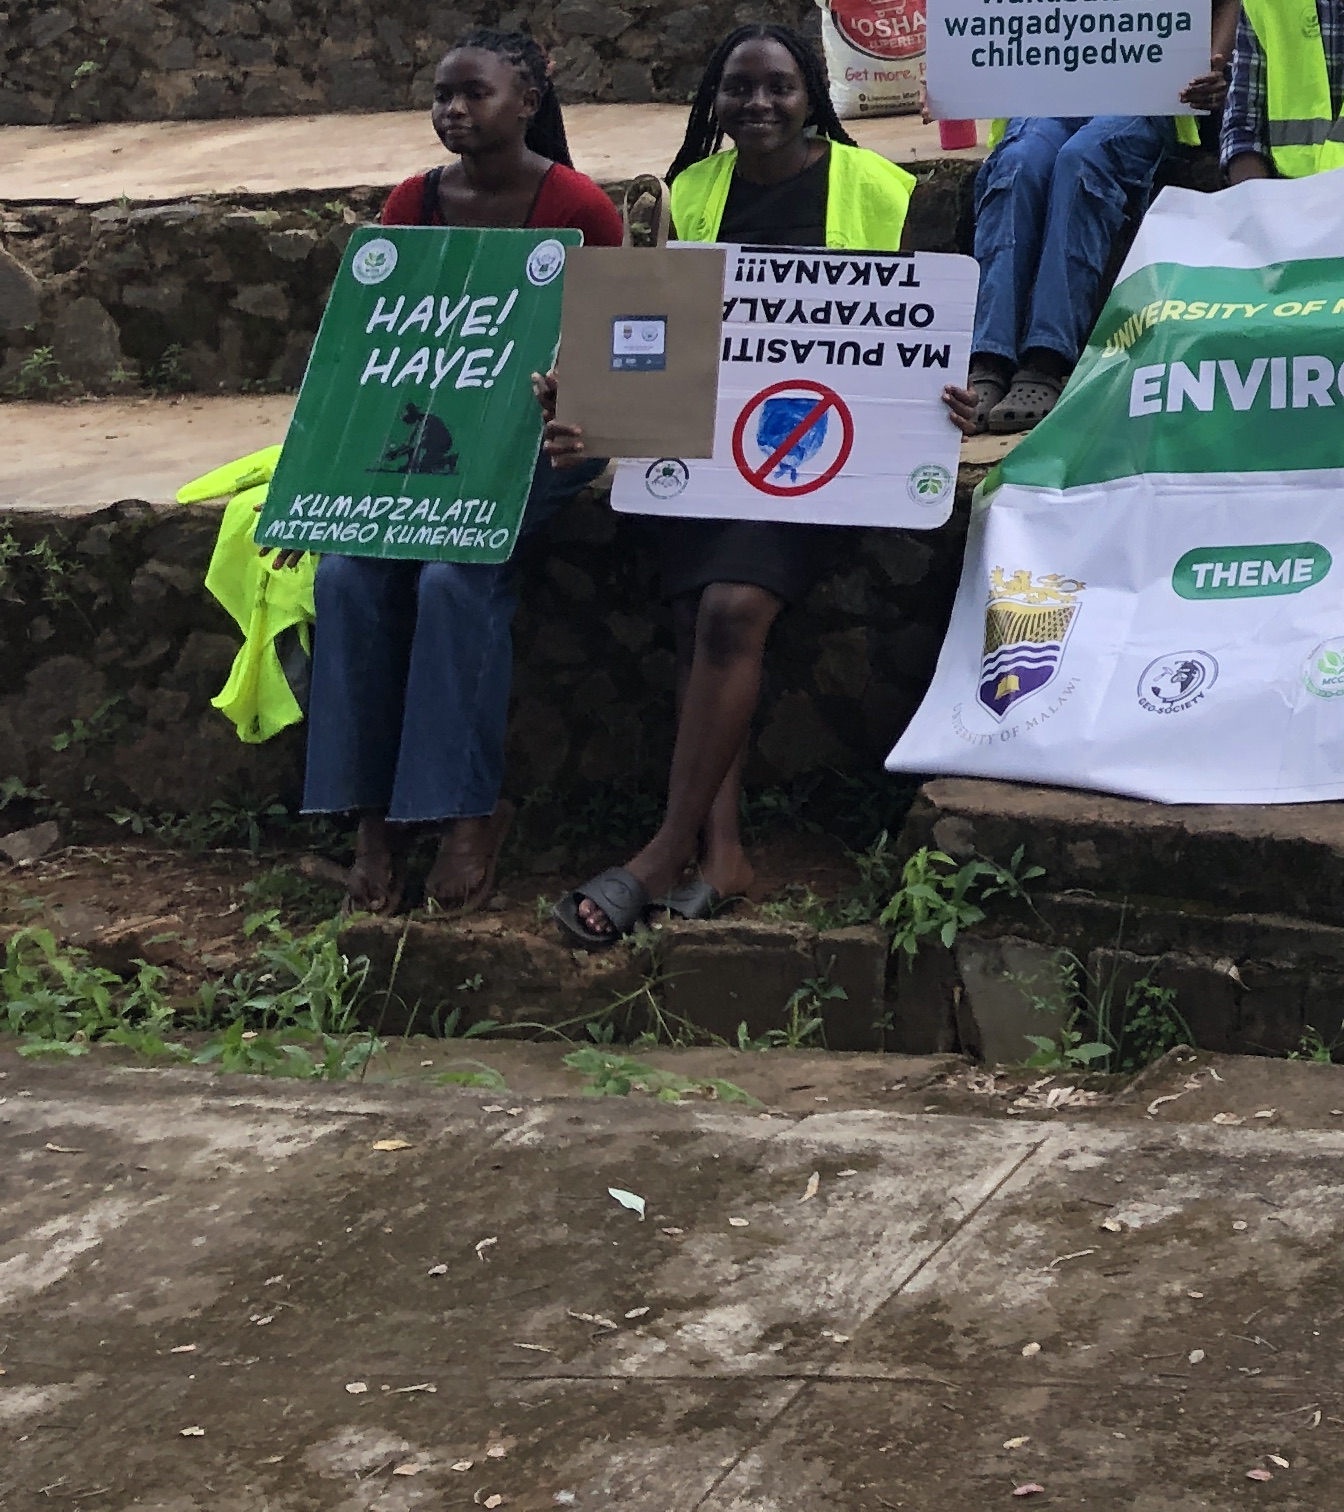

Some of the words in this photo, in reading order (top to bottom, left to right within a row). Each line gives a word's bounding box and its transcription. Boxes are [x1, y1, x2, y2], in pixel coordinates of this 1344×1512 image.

[944, 9, 1192, 47] wangadyonanga
[971, 37, 1164, 73] chilengedwe
[845, 66, 868, 82] Get
[874, 69, 917, 82] more,
[735, 257, 920, 288] TAKANA!!!
[365, 288, 519, 338] HAYE!
[722, 297, 935, 328] OPYAPYALA
[1102, 299, 1265, 358] UNIVERSITY
[1272, 299, 1322, 319] OF
[360, 339, 515, 389] HAYE!
[897, 342, 951, 369] MA
[289, 492, 497, 525] KUMADZALATU
[265, 518, 378, 543] MITENGO
[383, 524, 509, 549] KUMENEKO
[1190, 555, 1315, 590] THEME
[1000, 724, 1021, 742] OF
[1025, 676, 1082, 731] MALAWI
